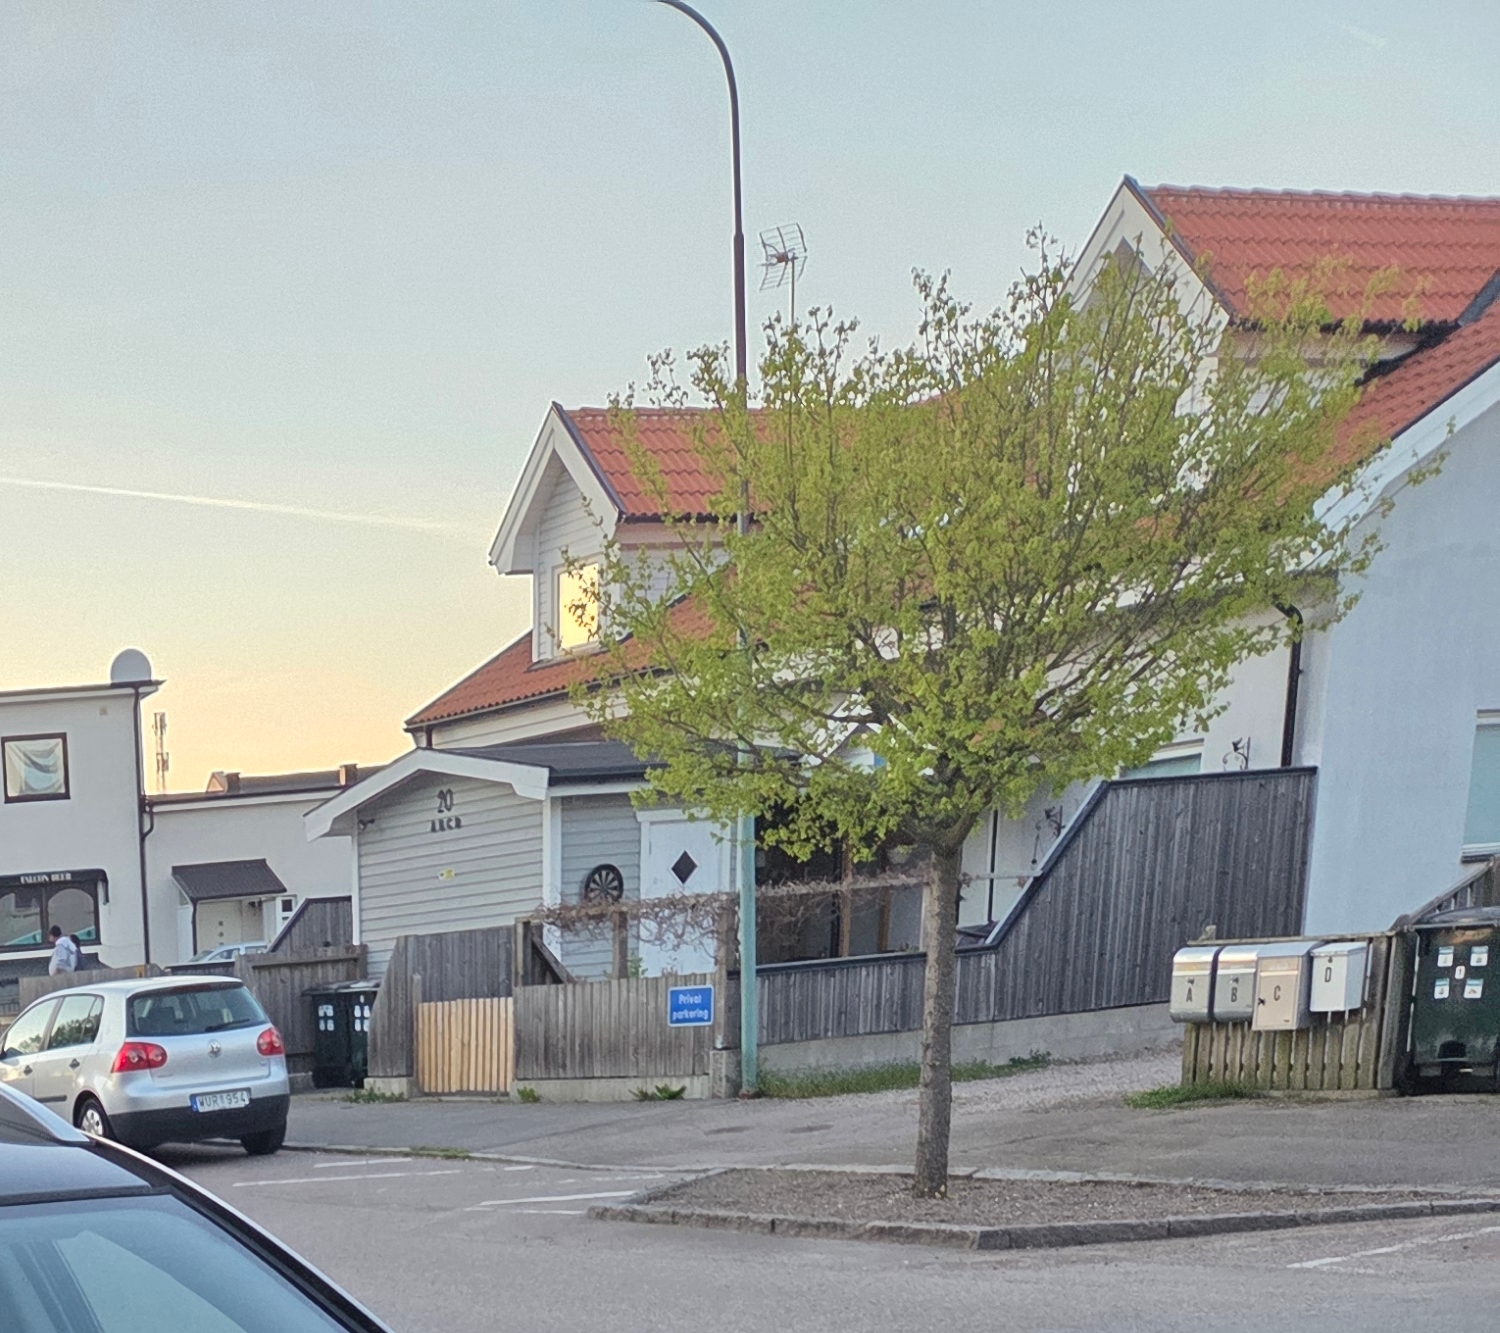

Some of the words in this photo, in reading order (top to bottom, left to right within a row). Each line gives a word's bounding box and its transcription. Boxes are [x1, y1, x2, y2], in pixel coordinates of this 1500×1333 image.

[1324, 966, 1332, 983] D
[679, 994, 702, 1004] Privat
[1186, 987, 1192, 1002] A
[1231, 987, 1238, 1002] B
[1274, 985, 1280, 1001] C
